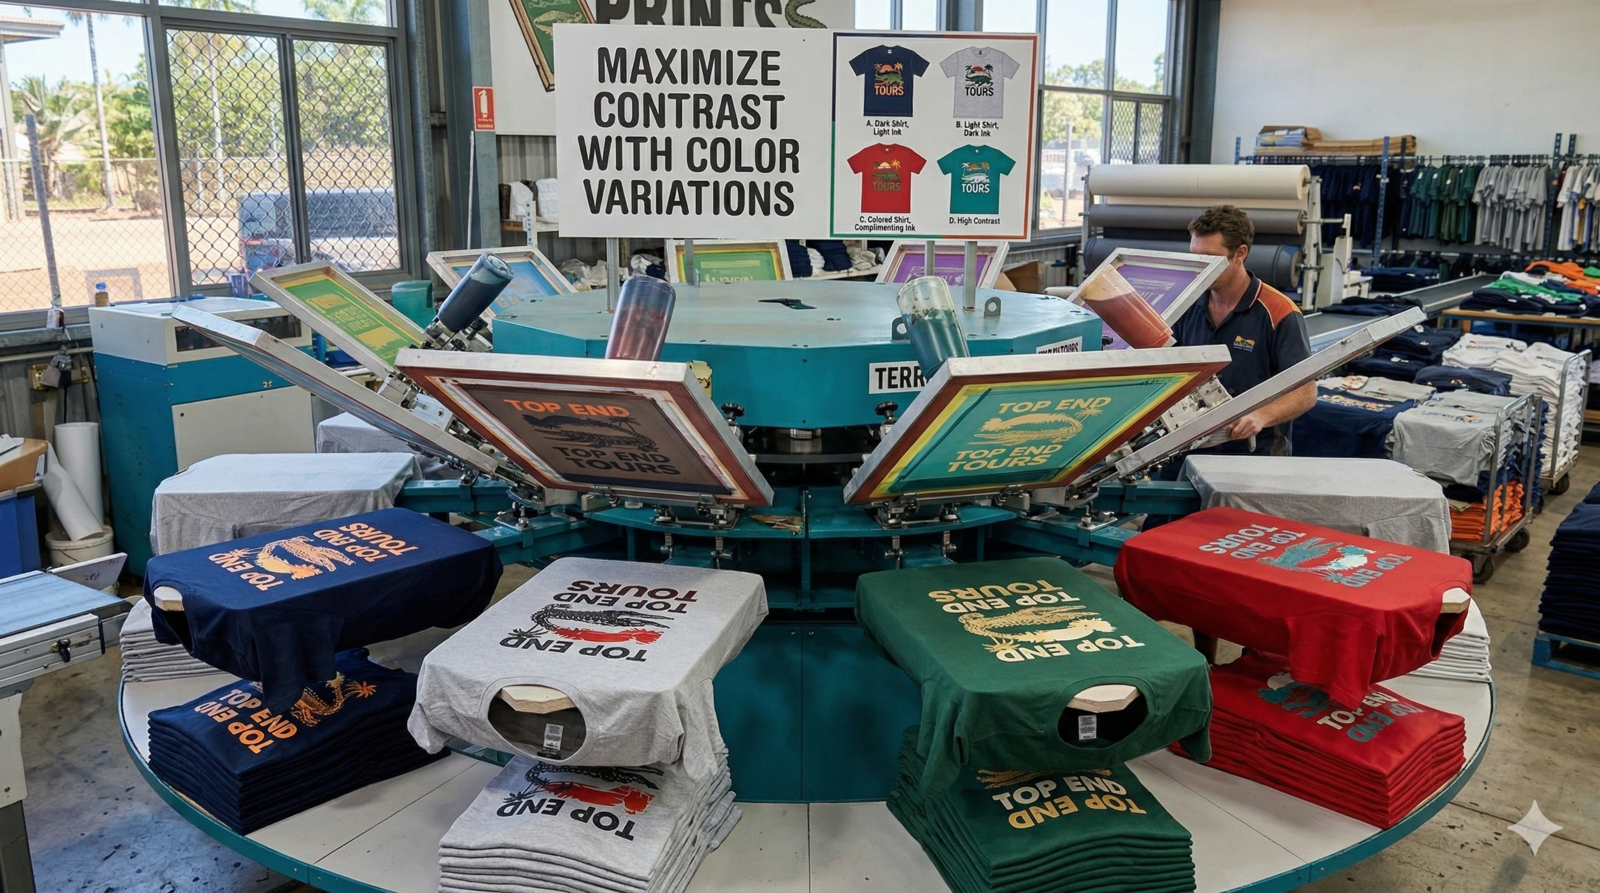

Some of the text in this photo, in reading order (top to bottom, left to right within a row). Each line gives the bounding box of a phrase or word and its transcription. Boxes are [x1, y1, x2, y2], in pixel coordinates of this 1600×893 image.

[597, 47, 781, 86] MAXIMIZE
[874, 85, 904, 96] TOURS
[965, 86, 994, 97] TOURS
[594, 92, 785, 130] CONTRAST
[873, 128, 902, 137] Light Ink
[891, 120, 909, 129] Shirt,
[956, 121, 999, 131] B. Light Shirt,
[578, 135, 800, 173] WITH COLOR
[583, 179, 795, 217] VARIATIONS
[872, 181, 901, 192] TOURS
[962, 183, 990, 194] TOURS
[854, 224, 916, 233] Complimenting Ink
[868, 216, 893, 224] Colored
[894, 216, 911, 225] Shirt,
[957, 217, 973, 226] High
[974, 217, 1001, 225] Contrast
[503, 399, 631, 418] TOP END
[998, 396, 1112, 414] TOP END
[554, 446, 670, 464] TOP END
[947, 454, 1051, 473] TOURS
[956, 444, 1063, 461] TOP END
[564, 457, 682, 476] TOURS
[313, 528, 388, 562] TOP END
[338, 522, 419, 557] TOURS
[1198, 523, 1278, 554] TOURS
[1230, 529, 1306, 561] TOP END
[208, 551, 284, 591] TOP END
[1340, 553, 1413, 588] TOP END
[552, 591, 688, 614] TOP END
[566, 580, 698, 602] TOURS
[928, 579, 1063, 603] TOURS
[942, 591, 1080, 613] TOP END
[499, 636, 648, 662] TOP END
[995, 634, 1145, 663] TOP END
[219, 688, 298, 740] TOP END
[1316, 708, 1364, 730] TO
[194, 701, 275, 755] TOP END
[1347, 711, 1395, 743] END
[992, 775, 1127, 810] TOP END
[496, 798, 635, 841] TOP END
[1008, 793, 1147, 829] TOP END
